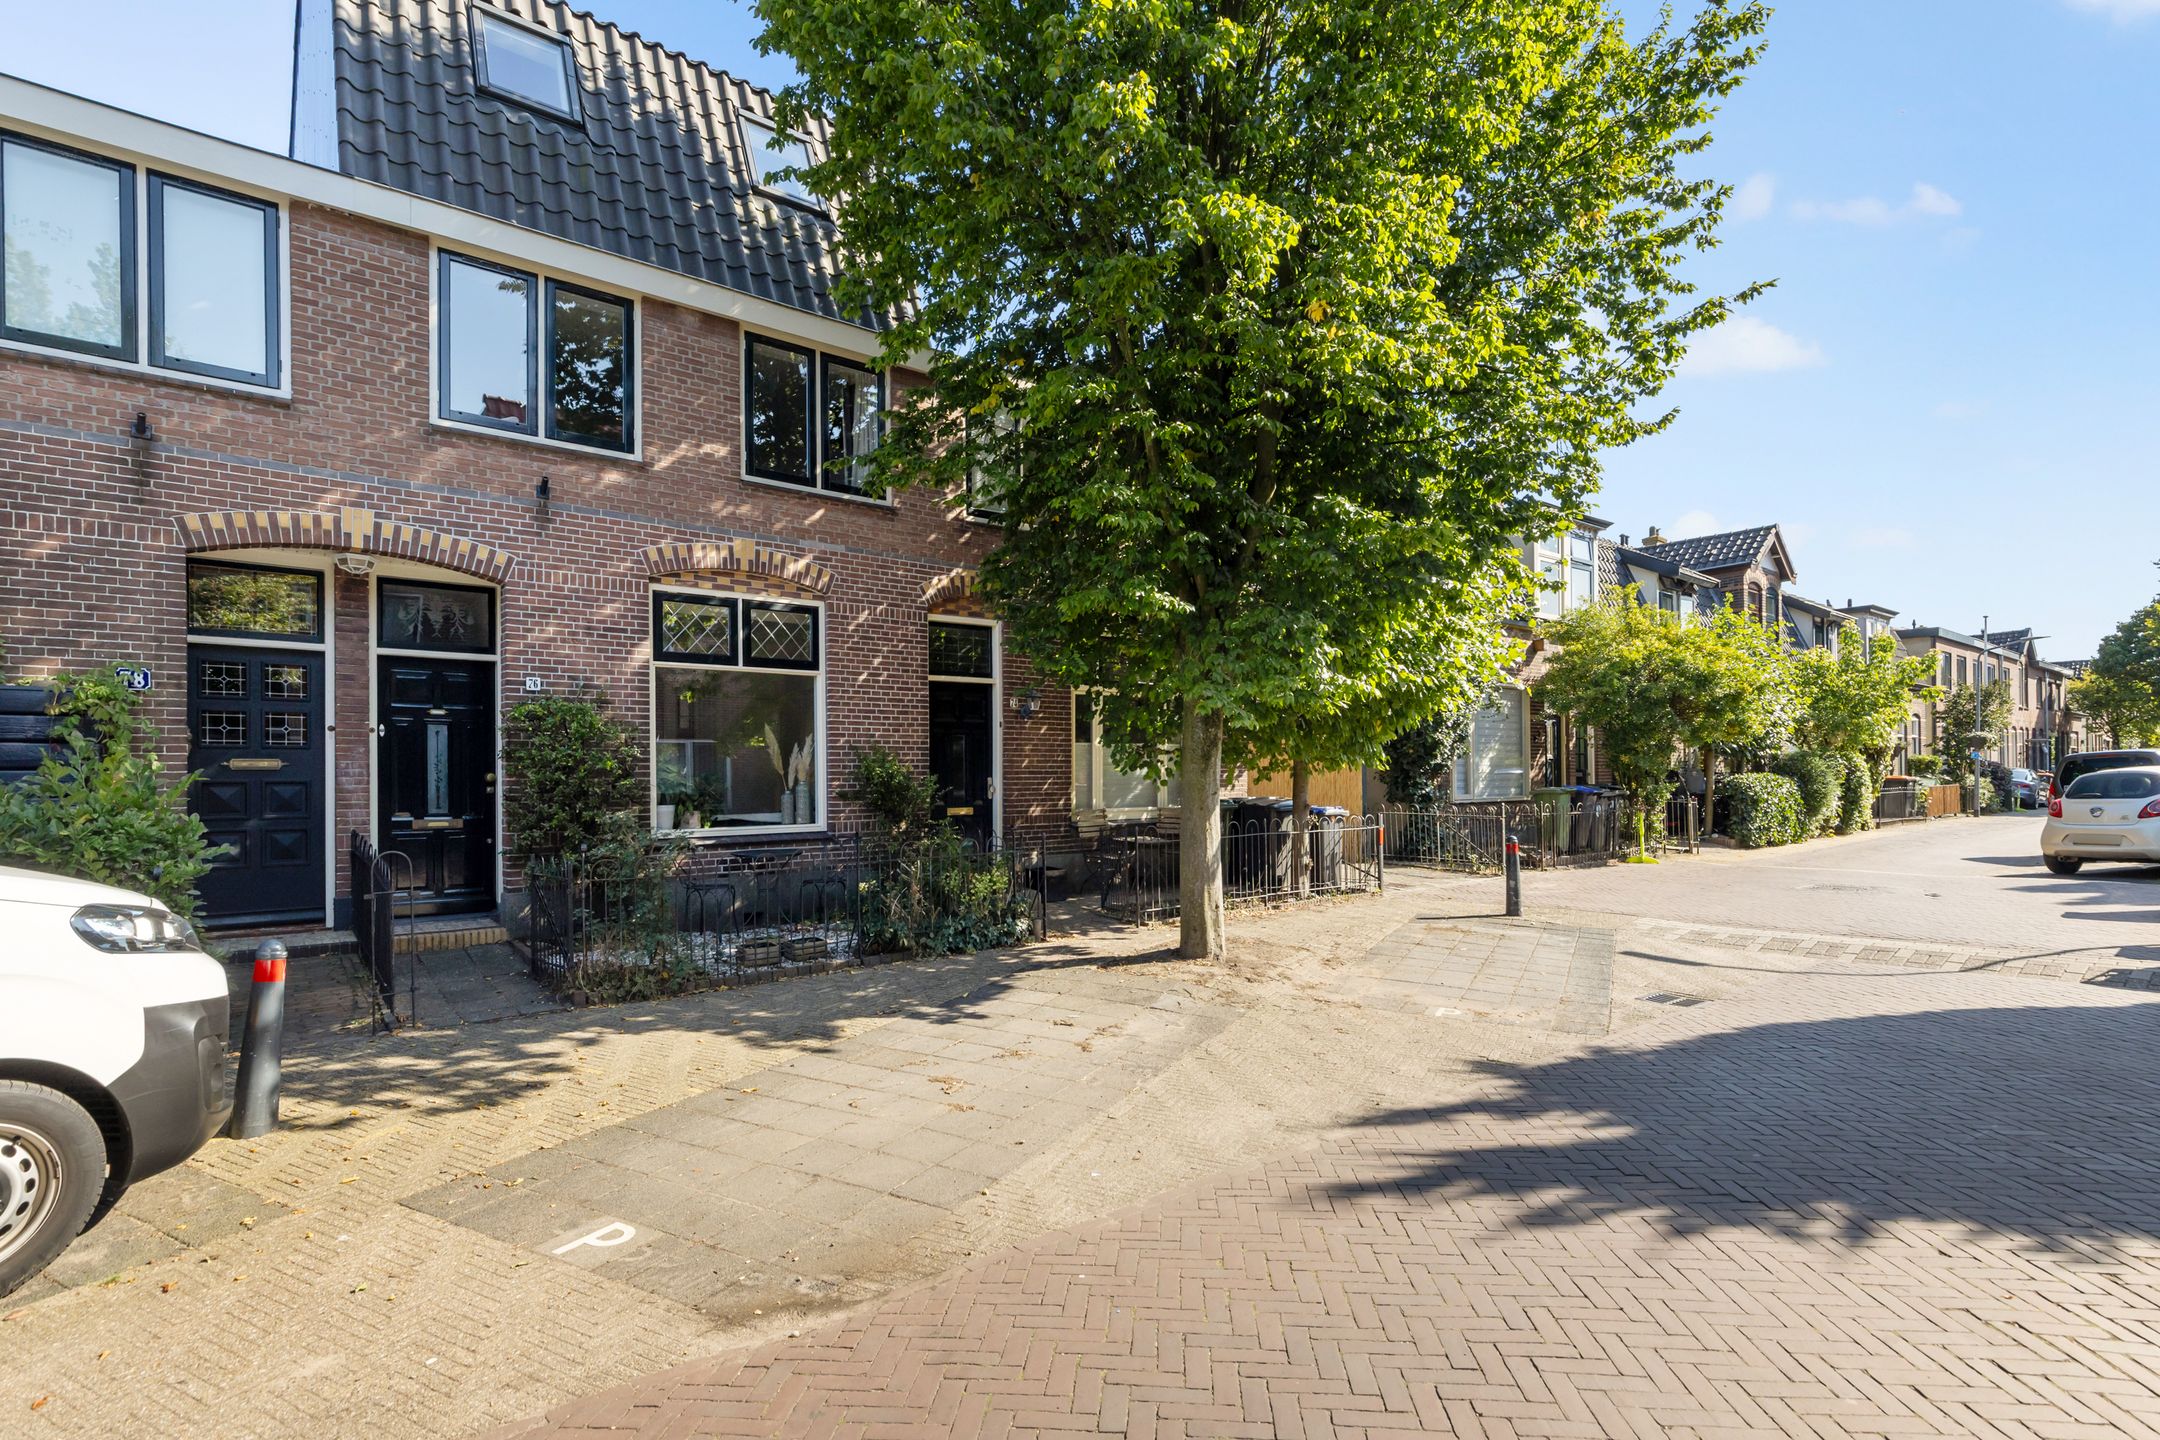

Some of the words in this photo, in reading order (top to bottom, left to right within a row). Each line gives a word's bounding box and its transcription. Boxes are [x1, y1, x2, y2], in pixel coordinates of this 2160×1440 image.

[528, 678, 539, 689] 76
[1435, 1007, 1461, 1017] P
[552, 1221, 636, 1255] P
